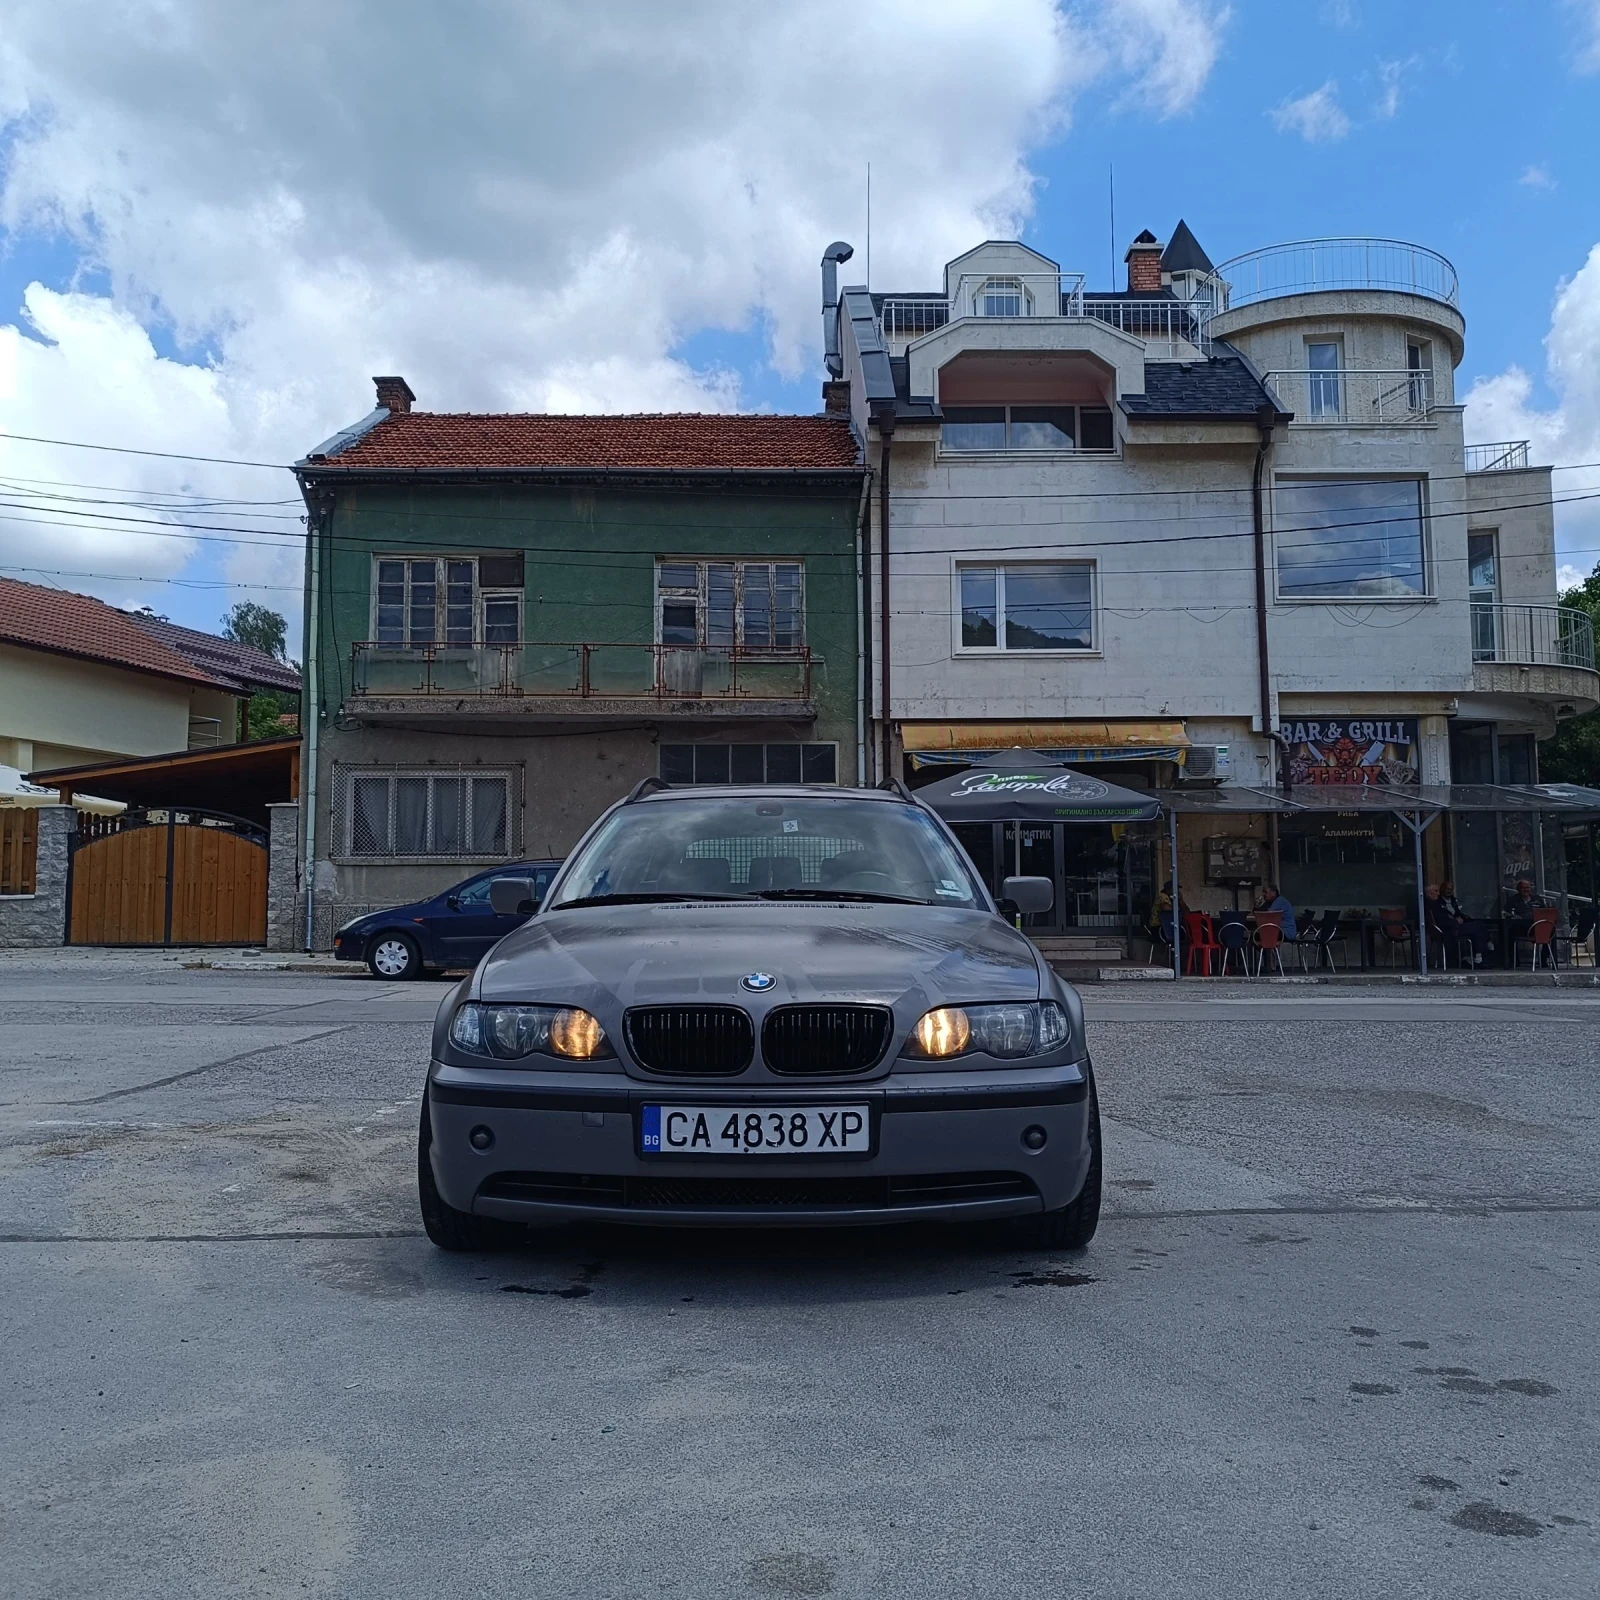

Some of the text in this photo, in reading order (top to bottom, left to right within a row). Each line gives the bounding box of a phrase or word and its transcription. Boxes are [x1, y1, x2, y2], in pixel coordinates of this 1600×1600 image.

[1279, 721, 1410, 745] BAR & GRILL
[1308, 765, 1383, 785] TEDY
[1054, 808, 1093, 816] ОРИГИНАЛНО
[666, 1111, 863, 1148] CA 4838 XP
[644, 1135, 659, 1146] BG
